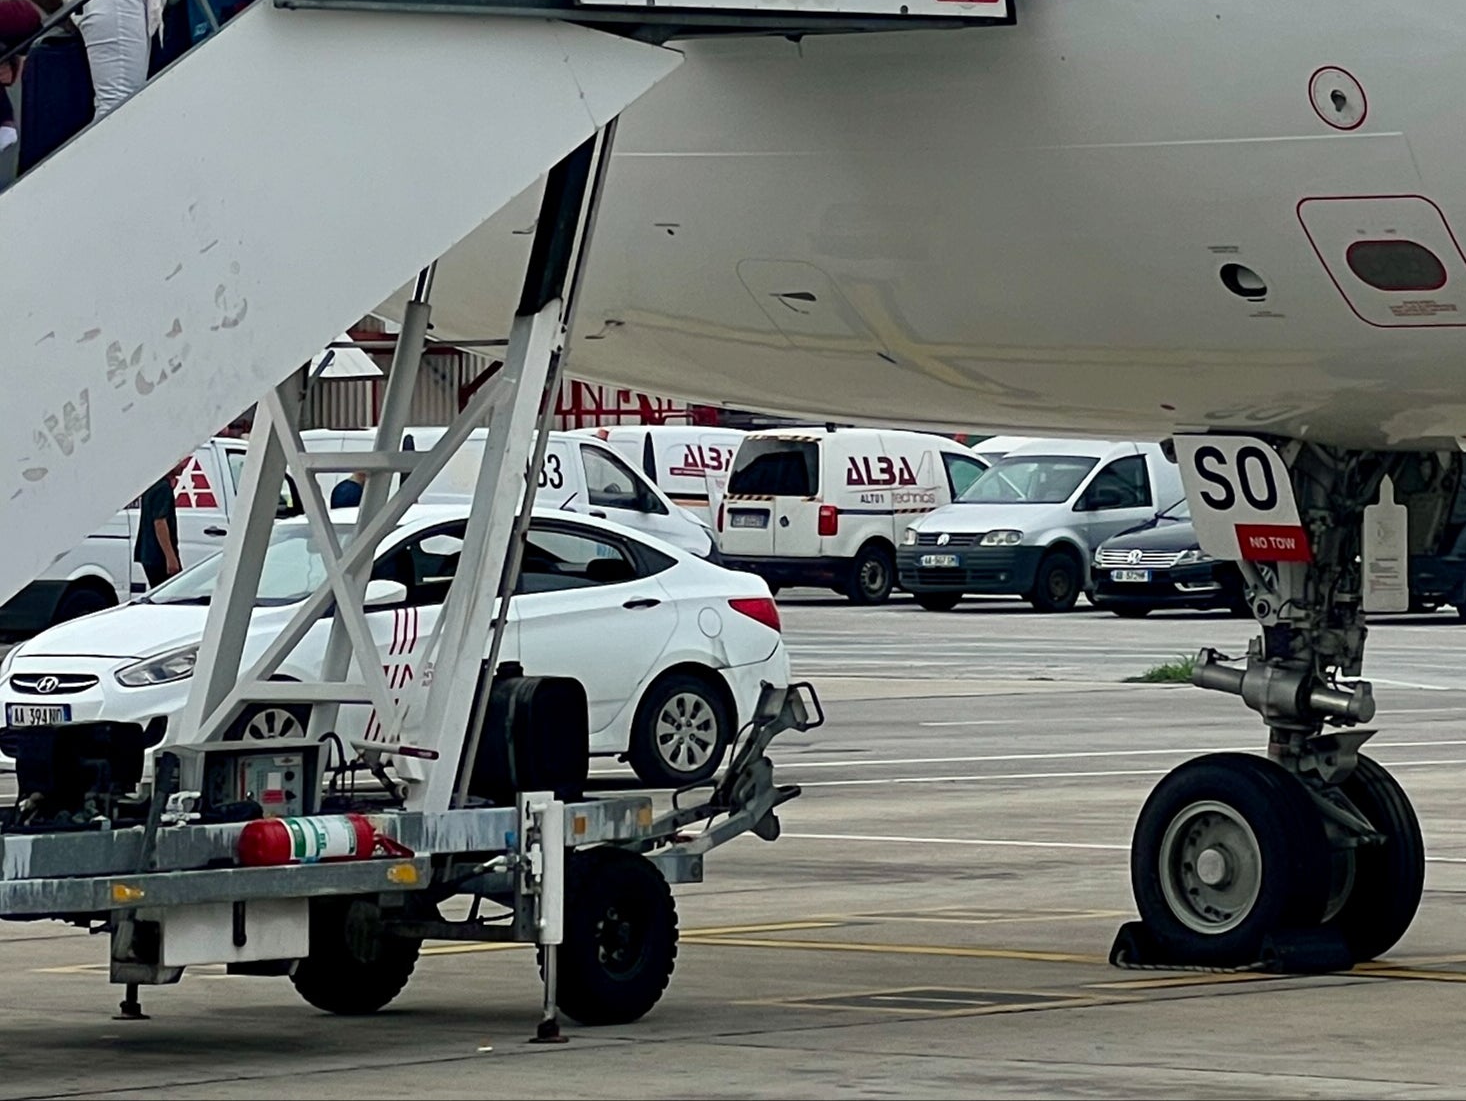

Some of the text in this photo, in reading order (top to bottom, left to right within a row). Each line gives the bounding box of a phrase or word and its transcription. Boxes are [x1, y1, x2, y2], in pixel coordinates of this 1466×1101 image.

[847, 456, 917, 485] ALBA
[1194, 446, 1278, 511] SO
[1250, 537, 1296, 549] NO TOW
[14, 707, 25, 723] AA
